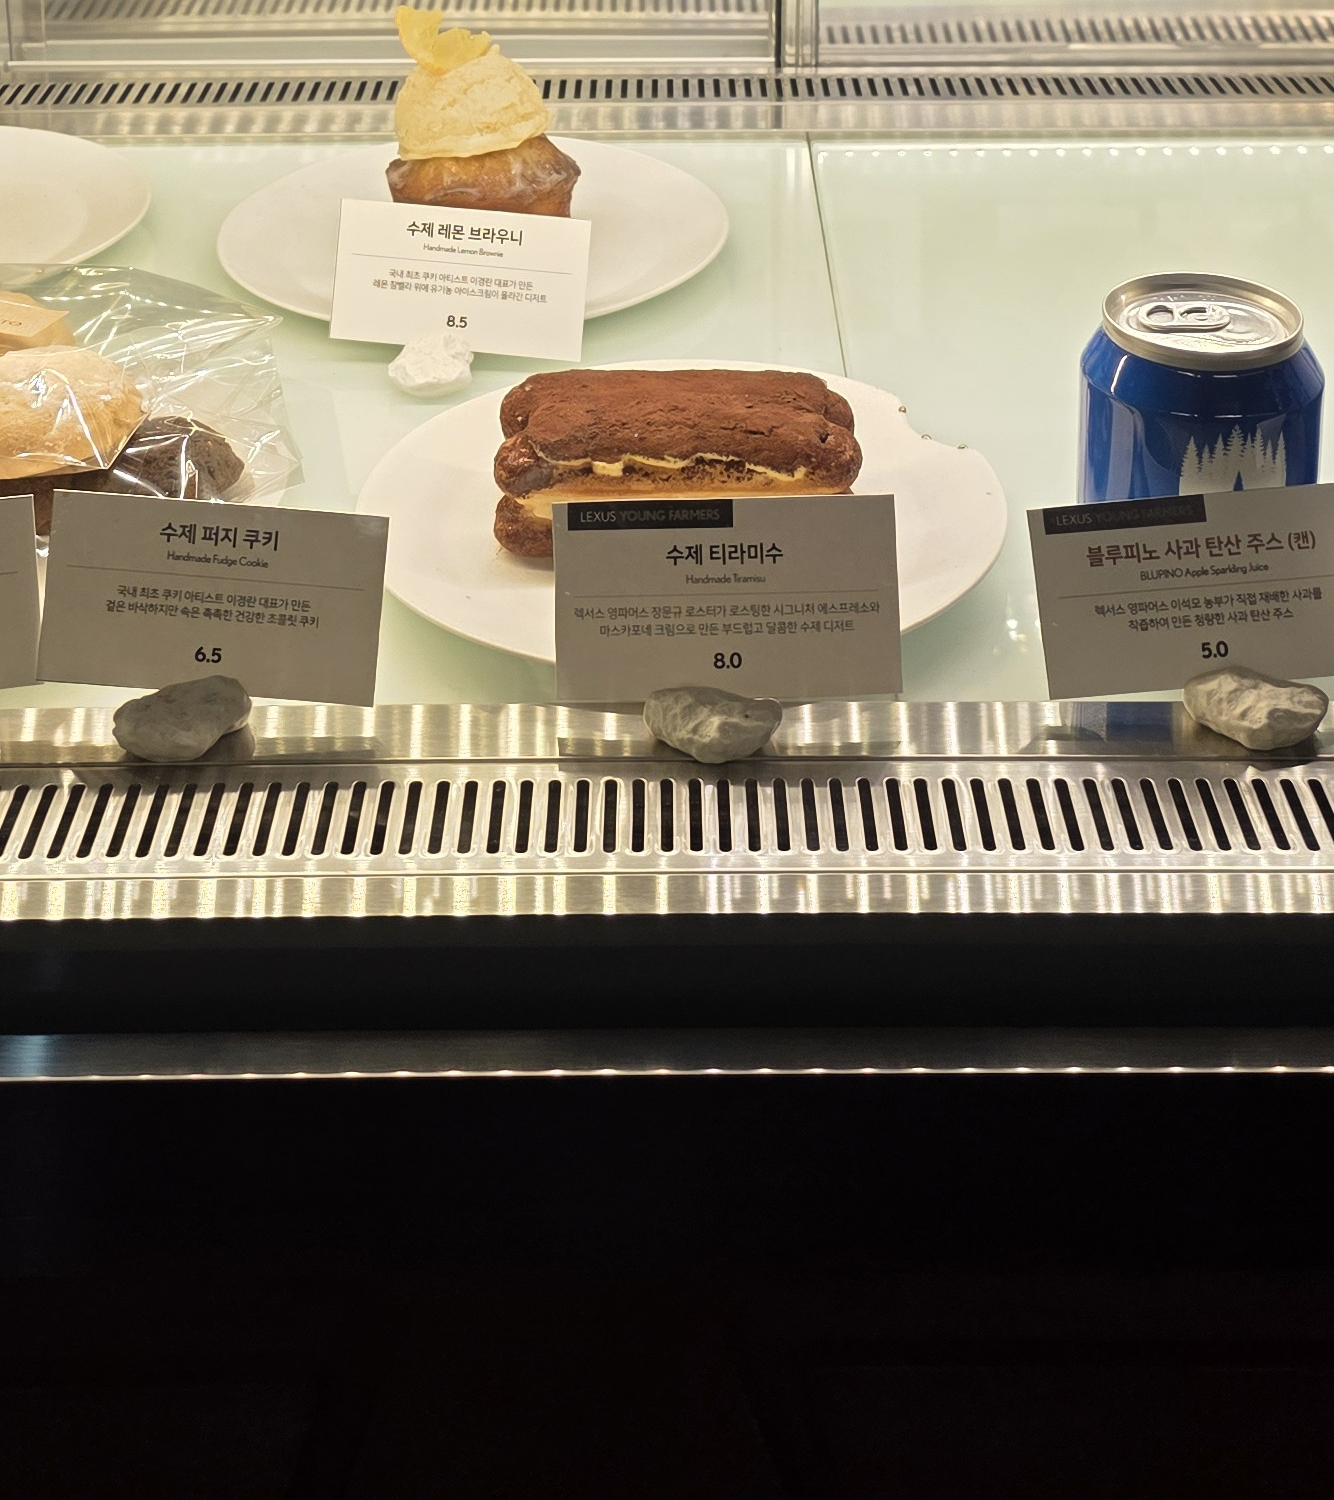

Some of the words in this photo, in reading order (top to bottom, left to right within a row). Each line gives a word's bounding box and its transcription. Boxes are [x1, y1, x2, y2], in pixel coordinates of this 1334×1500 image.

[406, 221, 435, 239] 수제
[437, 223, 466, 241] 레몬
[467, 226, 523, 247] 브라우니
[422, 242, 457, 254] Handmade
[457, 246, 479, 255] Lemon
[478, 247, 504, 258] Brownie
[0, 318, 23, 327] TO
[446, 314, 468, 329] 8.5
[580, 510, 617, 523] LEXUS
[619, 509, 666, 522] YOUNG
[668, 508, 720, 521] FARMERS
[159, 522, 197, 545] 수제
[200, 525, 238, 549] 퍼지
[242, 529, 279, 552] 쿠키
[665, 543, 703, 566] 수제
[709, 542, 784, 566] 티라미수
[1086, 541, 1161, 568] 블루피노
[1164, 537, 1202, 561] 사과
[1204, 533, 1242, 558] 탄산
[1246, 532, 1285, 555] 주스
[1287, 530, 1316, 552] (캔)
[166, 550, 212, 564] Handmade
[212, 553, 238, 568] Fudge
[238, 556, 269, 569] Cookie
[685, 573, 732, 585] Handmade
[732, 573, 767, 584] Tiramisu
[194, 646, 222, 664] 6.5
[1201, 640, 1229, 660] 5.0
[713, 651, 743, 670] 8.0
